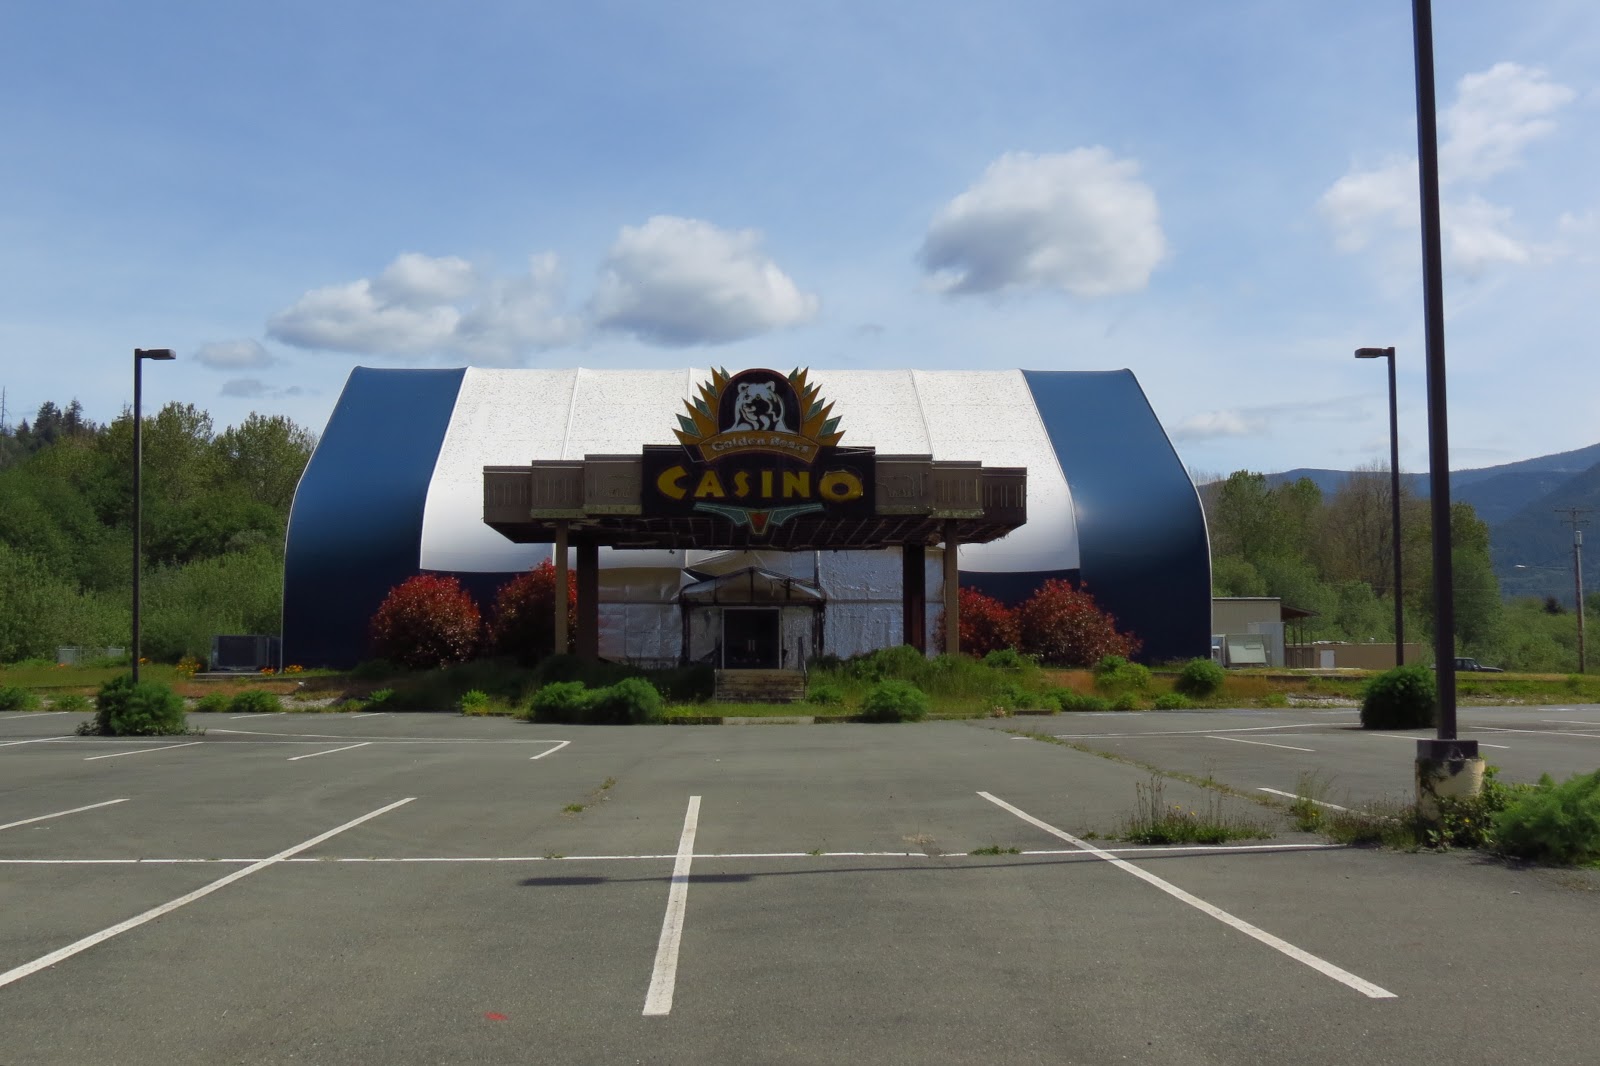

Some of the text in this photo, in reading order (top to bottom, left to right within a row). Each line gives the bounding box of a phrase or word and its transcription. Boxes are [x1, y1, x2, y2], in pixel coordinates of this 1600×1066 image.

[711, 436, 809, 453] Golden Bears
[657, 466, 863, 502] CASINO
